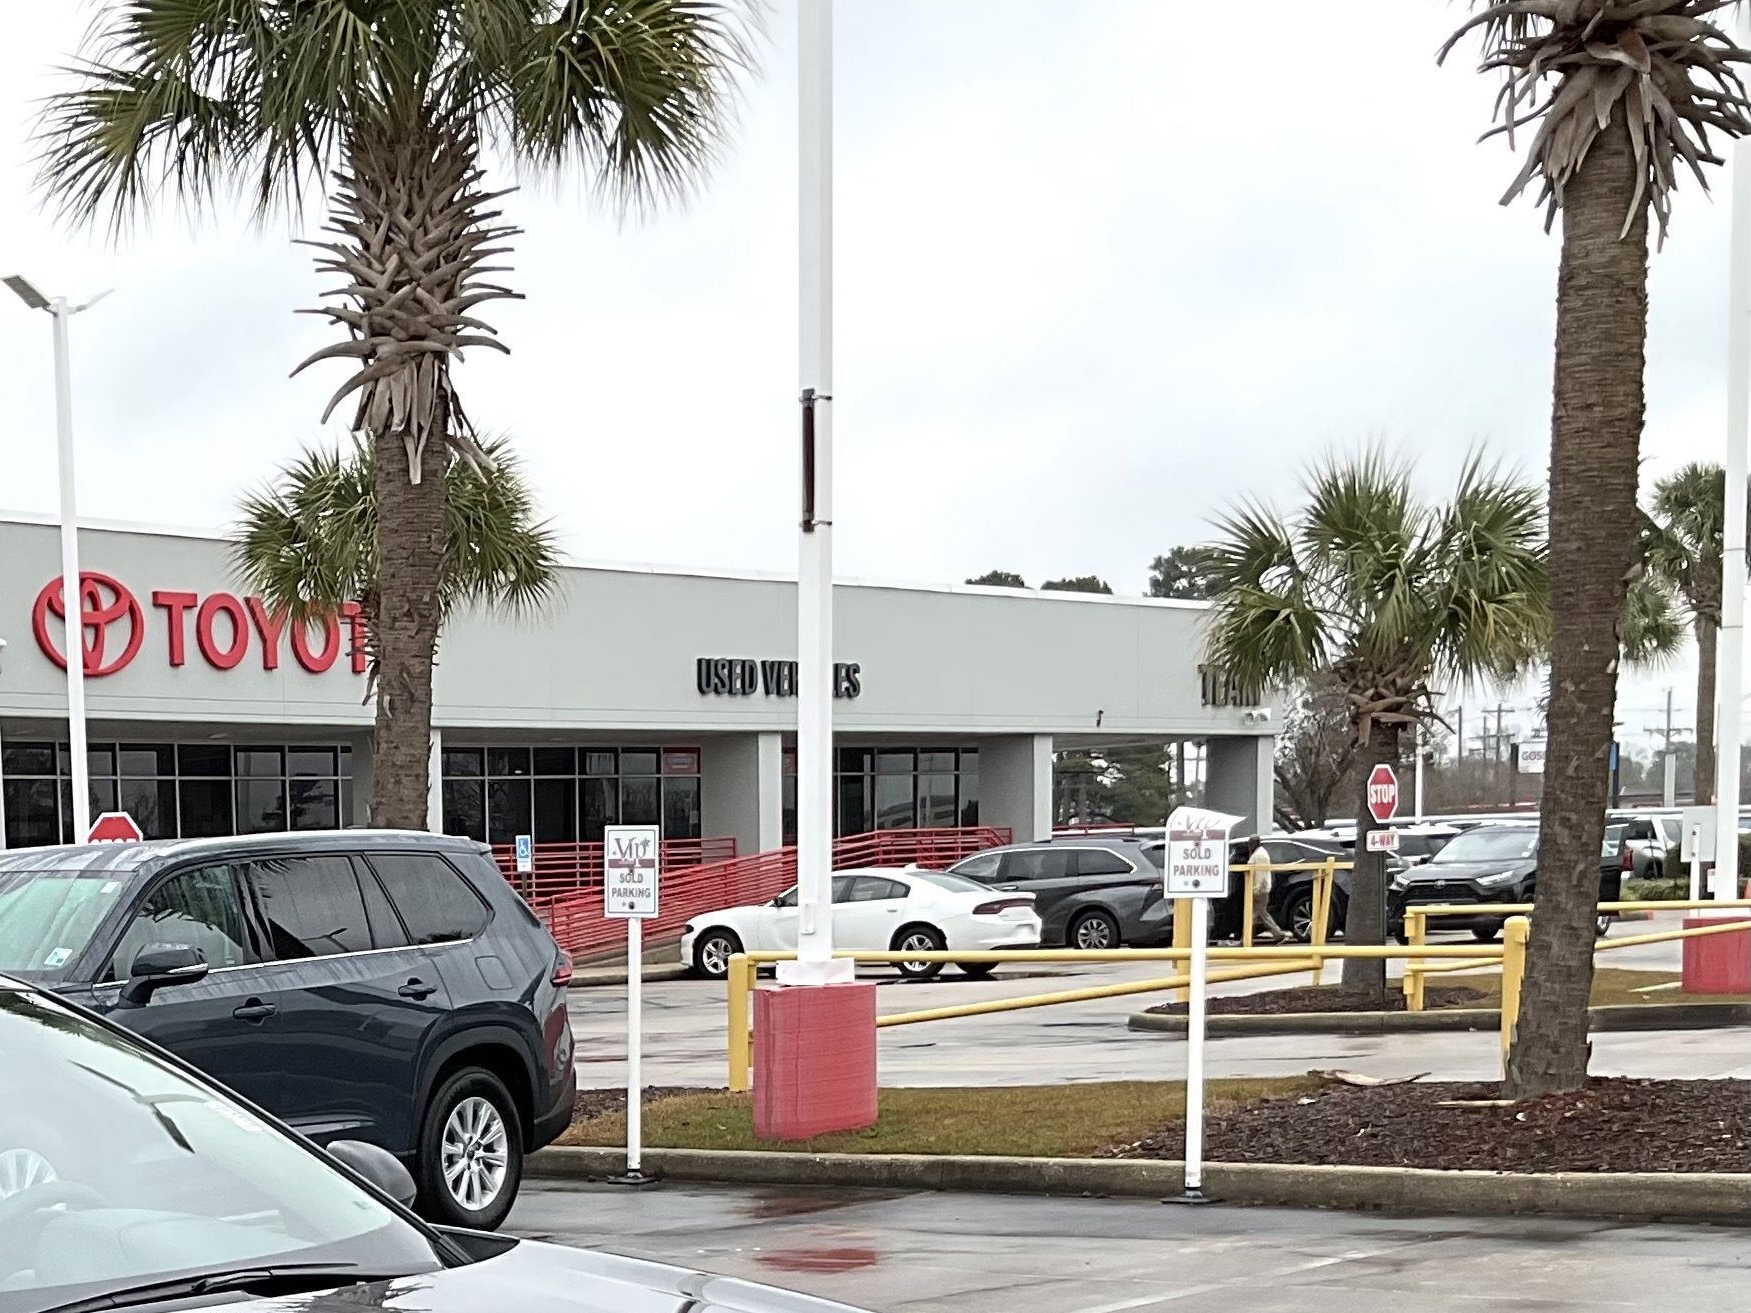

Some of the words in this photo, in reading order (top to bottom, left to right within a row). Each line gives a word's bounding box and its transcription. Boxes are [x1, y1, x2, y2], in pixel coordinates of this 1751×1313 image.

[152, 591, 365, 673] TOYOT
[697, 658, 758, 696] USED
[760, 660, 861, 699] VEHES
[1522, 751, 1546, 761] GOS
[1370, 784, 1395, 804] STOP
[1370, 833, 1395, 847] 4-WAY
[1182, 847, 1212, 860] SOLD
[1173, 864, 1220, 877] PARKING
[619, 872, 644, 884] SOLD
[612, 887, 651, 898] PARKING
